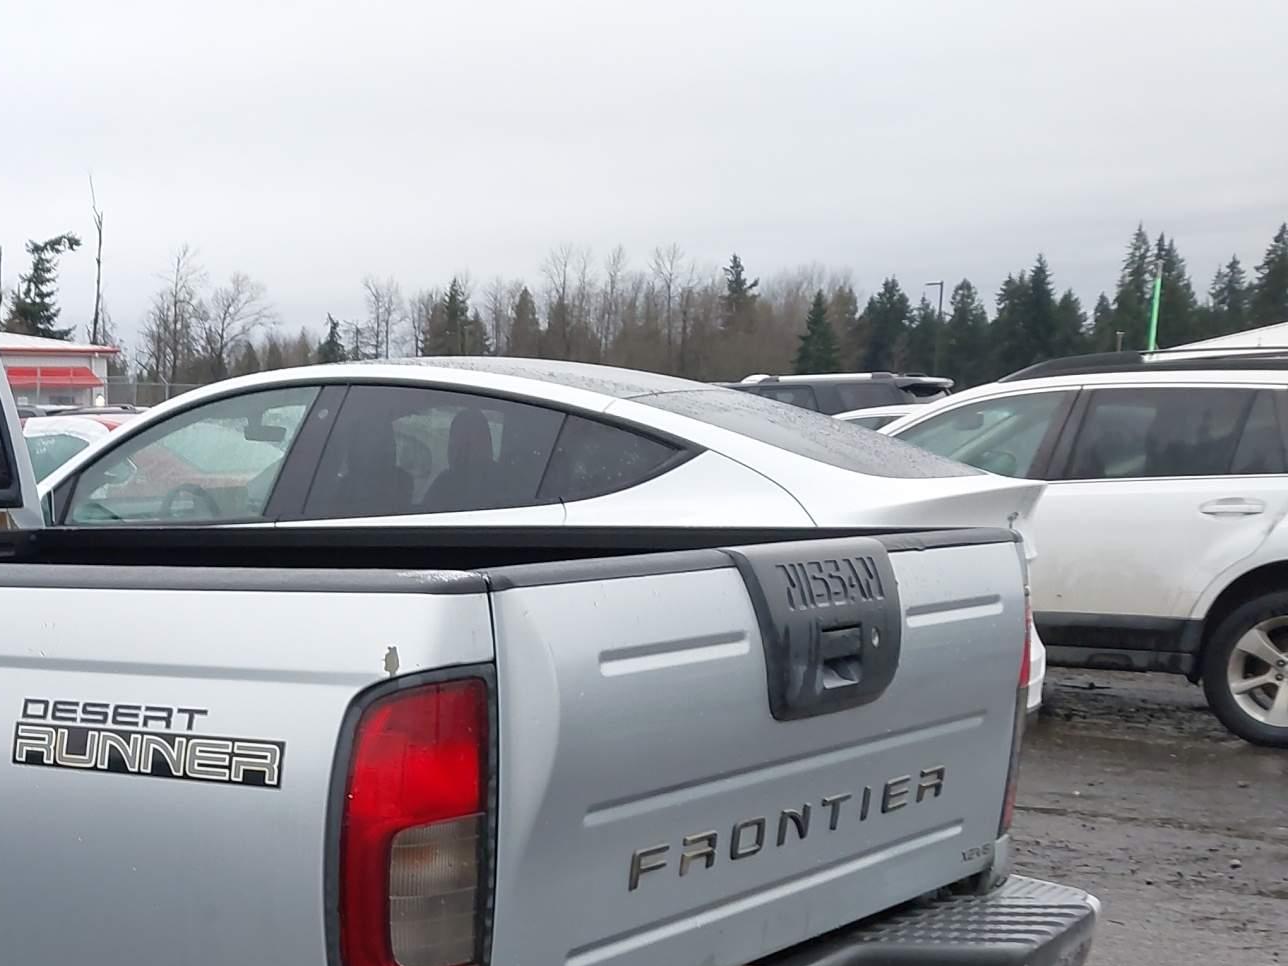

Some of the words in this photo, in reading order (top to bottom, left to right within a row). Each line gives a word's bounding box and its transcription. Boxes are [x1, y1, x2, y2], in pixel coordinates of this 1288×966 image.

[776, 556, 885, 611] NISSAN
[21, 698, 208, 731] DESERT
[15, 724, 281, 786] RUNNER
[628, 765, 945, 892] FRONTIER
